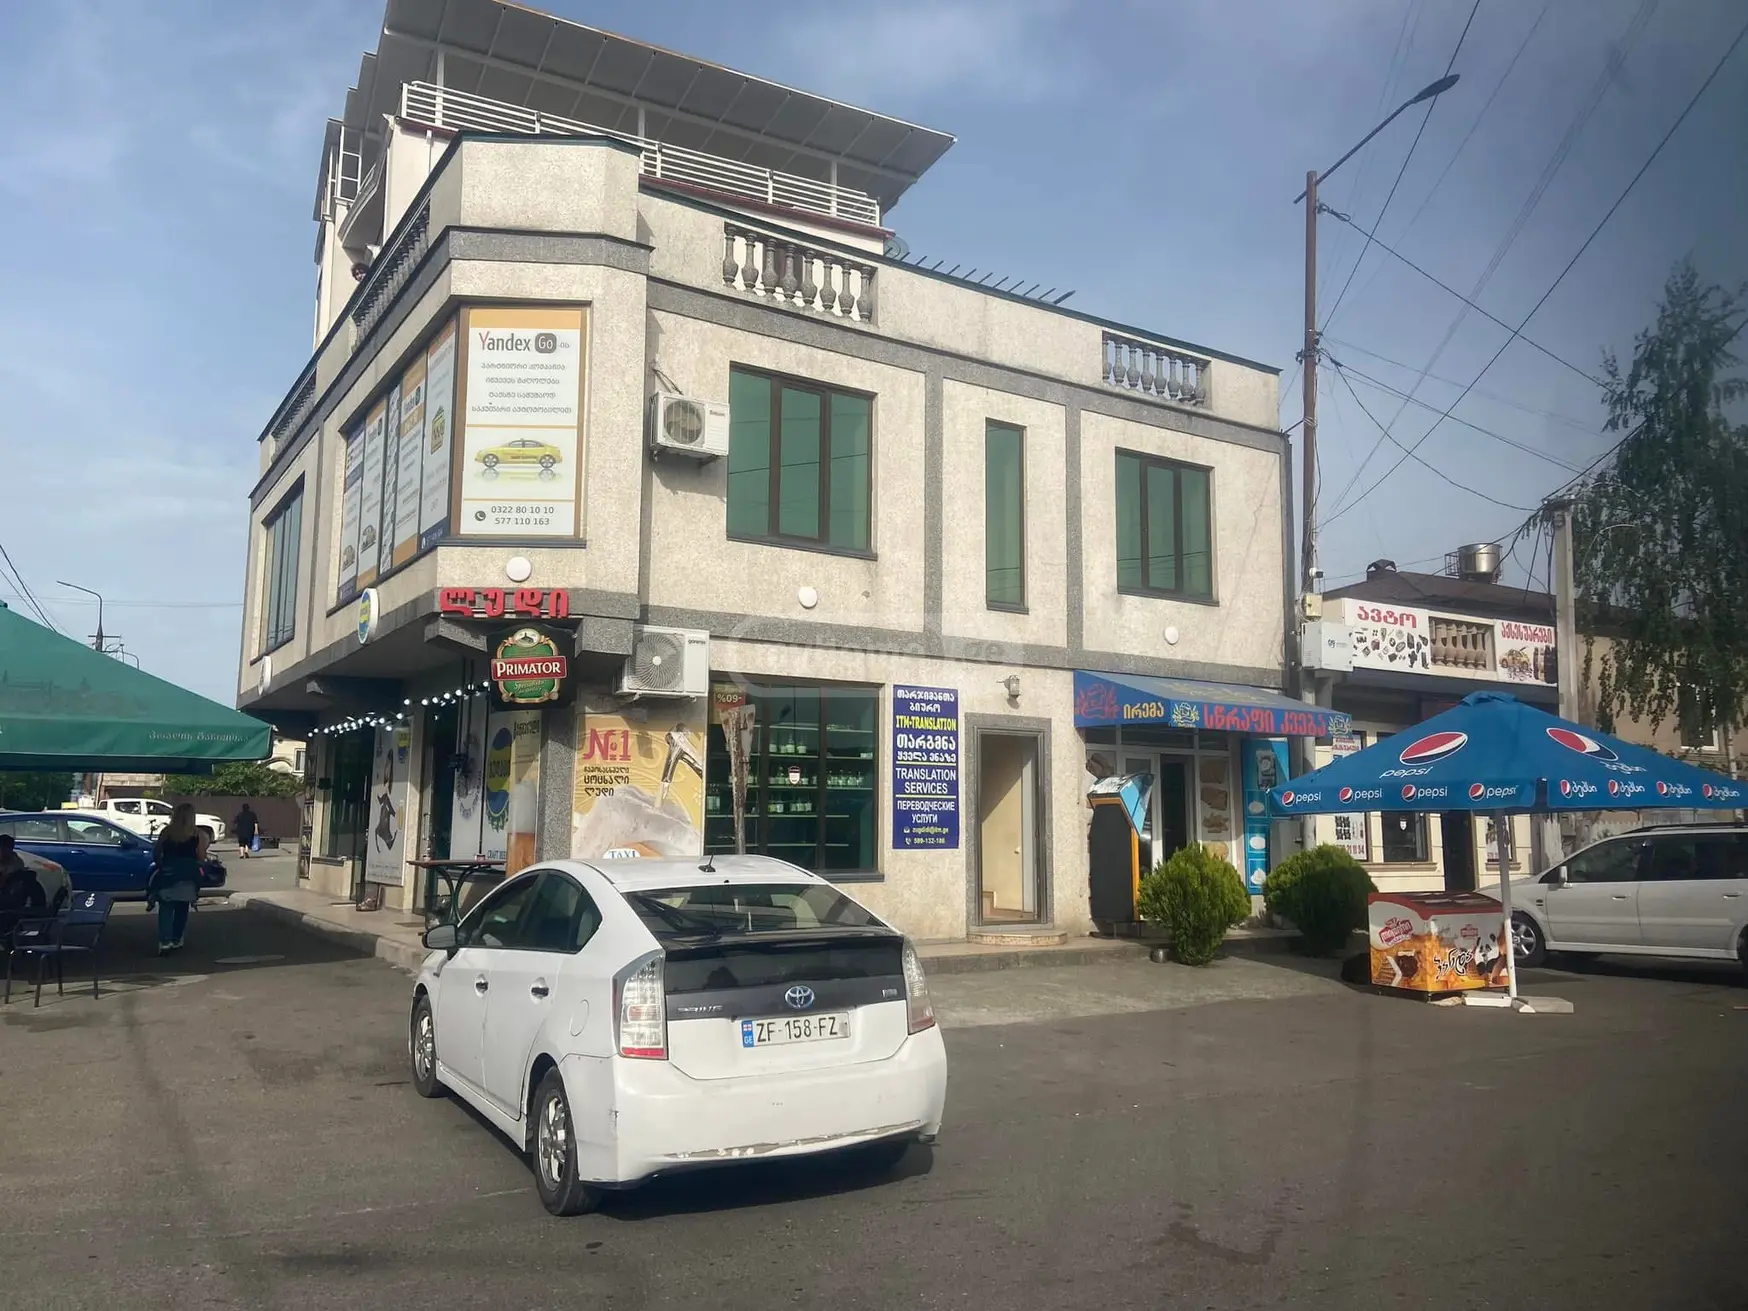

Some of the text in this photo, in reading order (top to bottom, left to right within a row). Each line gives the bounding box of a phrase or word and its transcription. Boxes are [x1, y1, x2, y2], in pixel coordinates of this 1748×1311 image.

[479, 331, 531, 351] Yandex
[538, 336, 554, 349] Go
[491, 506, 554, 514] 0322 80 10 10
[494, 517, 550, 526] 577 110 163
[439, 587, 569, 618] ლუდი
[1357, 606, 1417, 629] ავტო
[1501, 622, 1553, 644] აქსესუარები
[496, 661, 561, 677] PRIMATOR
[896, 689, 955, 702] თარჯიმანთა
[909, 702, 941, 713] ბიურო
[1123, 701, 1164, 719] ირემა
[895, 715, 957, 731] ITM-TRANSLATION
[1203, 703, 1326, 737] სწრაფი კვება
[583, 728, 632, 761] №1
[896, 733, 956, 750] თარგმნა
[897, 751, 956, 762] ყველა ენაზე
[895, 768, 957, 780] TRANSLATION
[1379, 766, 1434, 779] pepsi
[584, 775, 630, 785] ცოცხალი
[584, 787, 615, 797] ლუდი
[904, 782, 948, 794] SERVICES
[1295, 785, 1519, 804] pepsi pepsi pepsi pepsi
[897, 801, 955, 812] ПЕРЕВОДЧЕСКИЕ
[911, 813, 938, 824] УСЛУГИ
[609, 850, 636, 858] TAXI
[755, 1016, 838, 1043] ZF-158-FZ
[743, 1035, 753, 1045] GE
